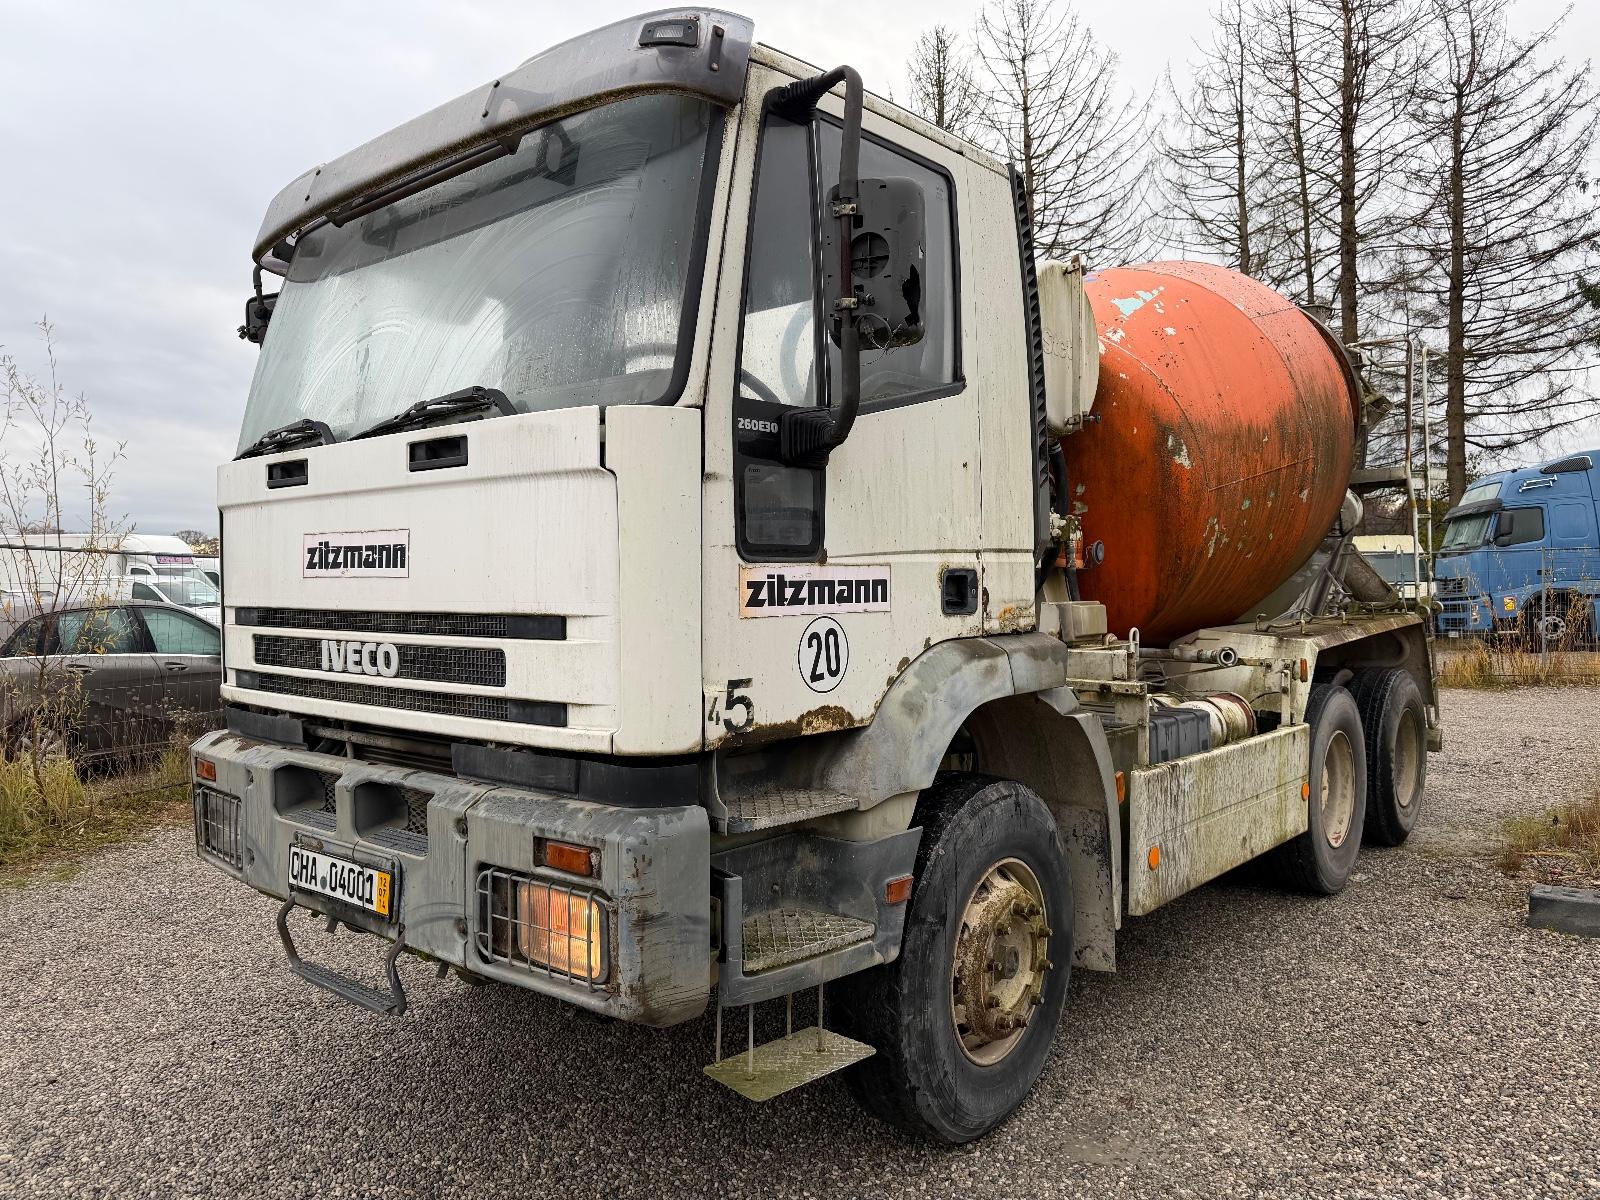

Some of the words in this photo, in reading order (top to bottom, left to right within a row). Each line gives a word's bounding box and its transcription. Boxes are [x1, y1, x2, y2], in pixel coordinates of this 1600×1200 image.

[737, 417, 779, 434] 260E30
[305, 541, 406, 570] zitzmann
[744, 574, 888, 608] zitzmann
[321, 639, 399, 678] IVECO
[807, 627, 841, 684] 20
[291, 851, 318, 887] CHA
[328, 861, 375, 906] 04001
[378, 888, 387, 898] 07
[380, 876, 387, 888] 12
